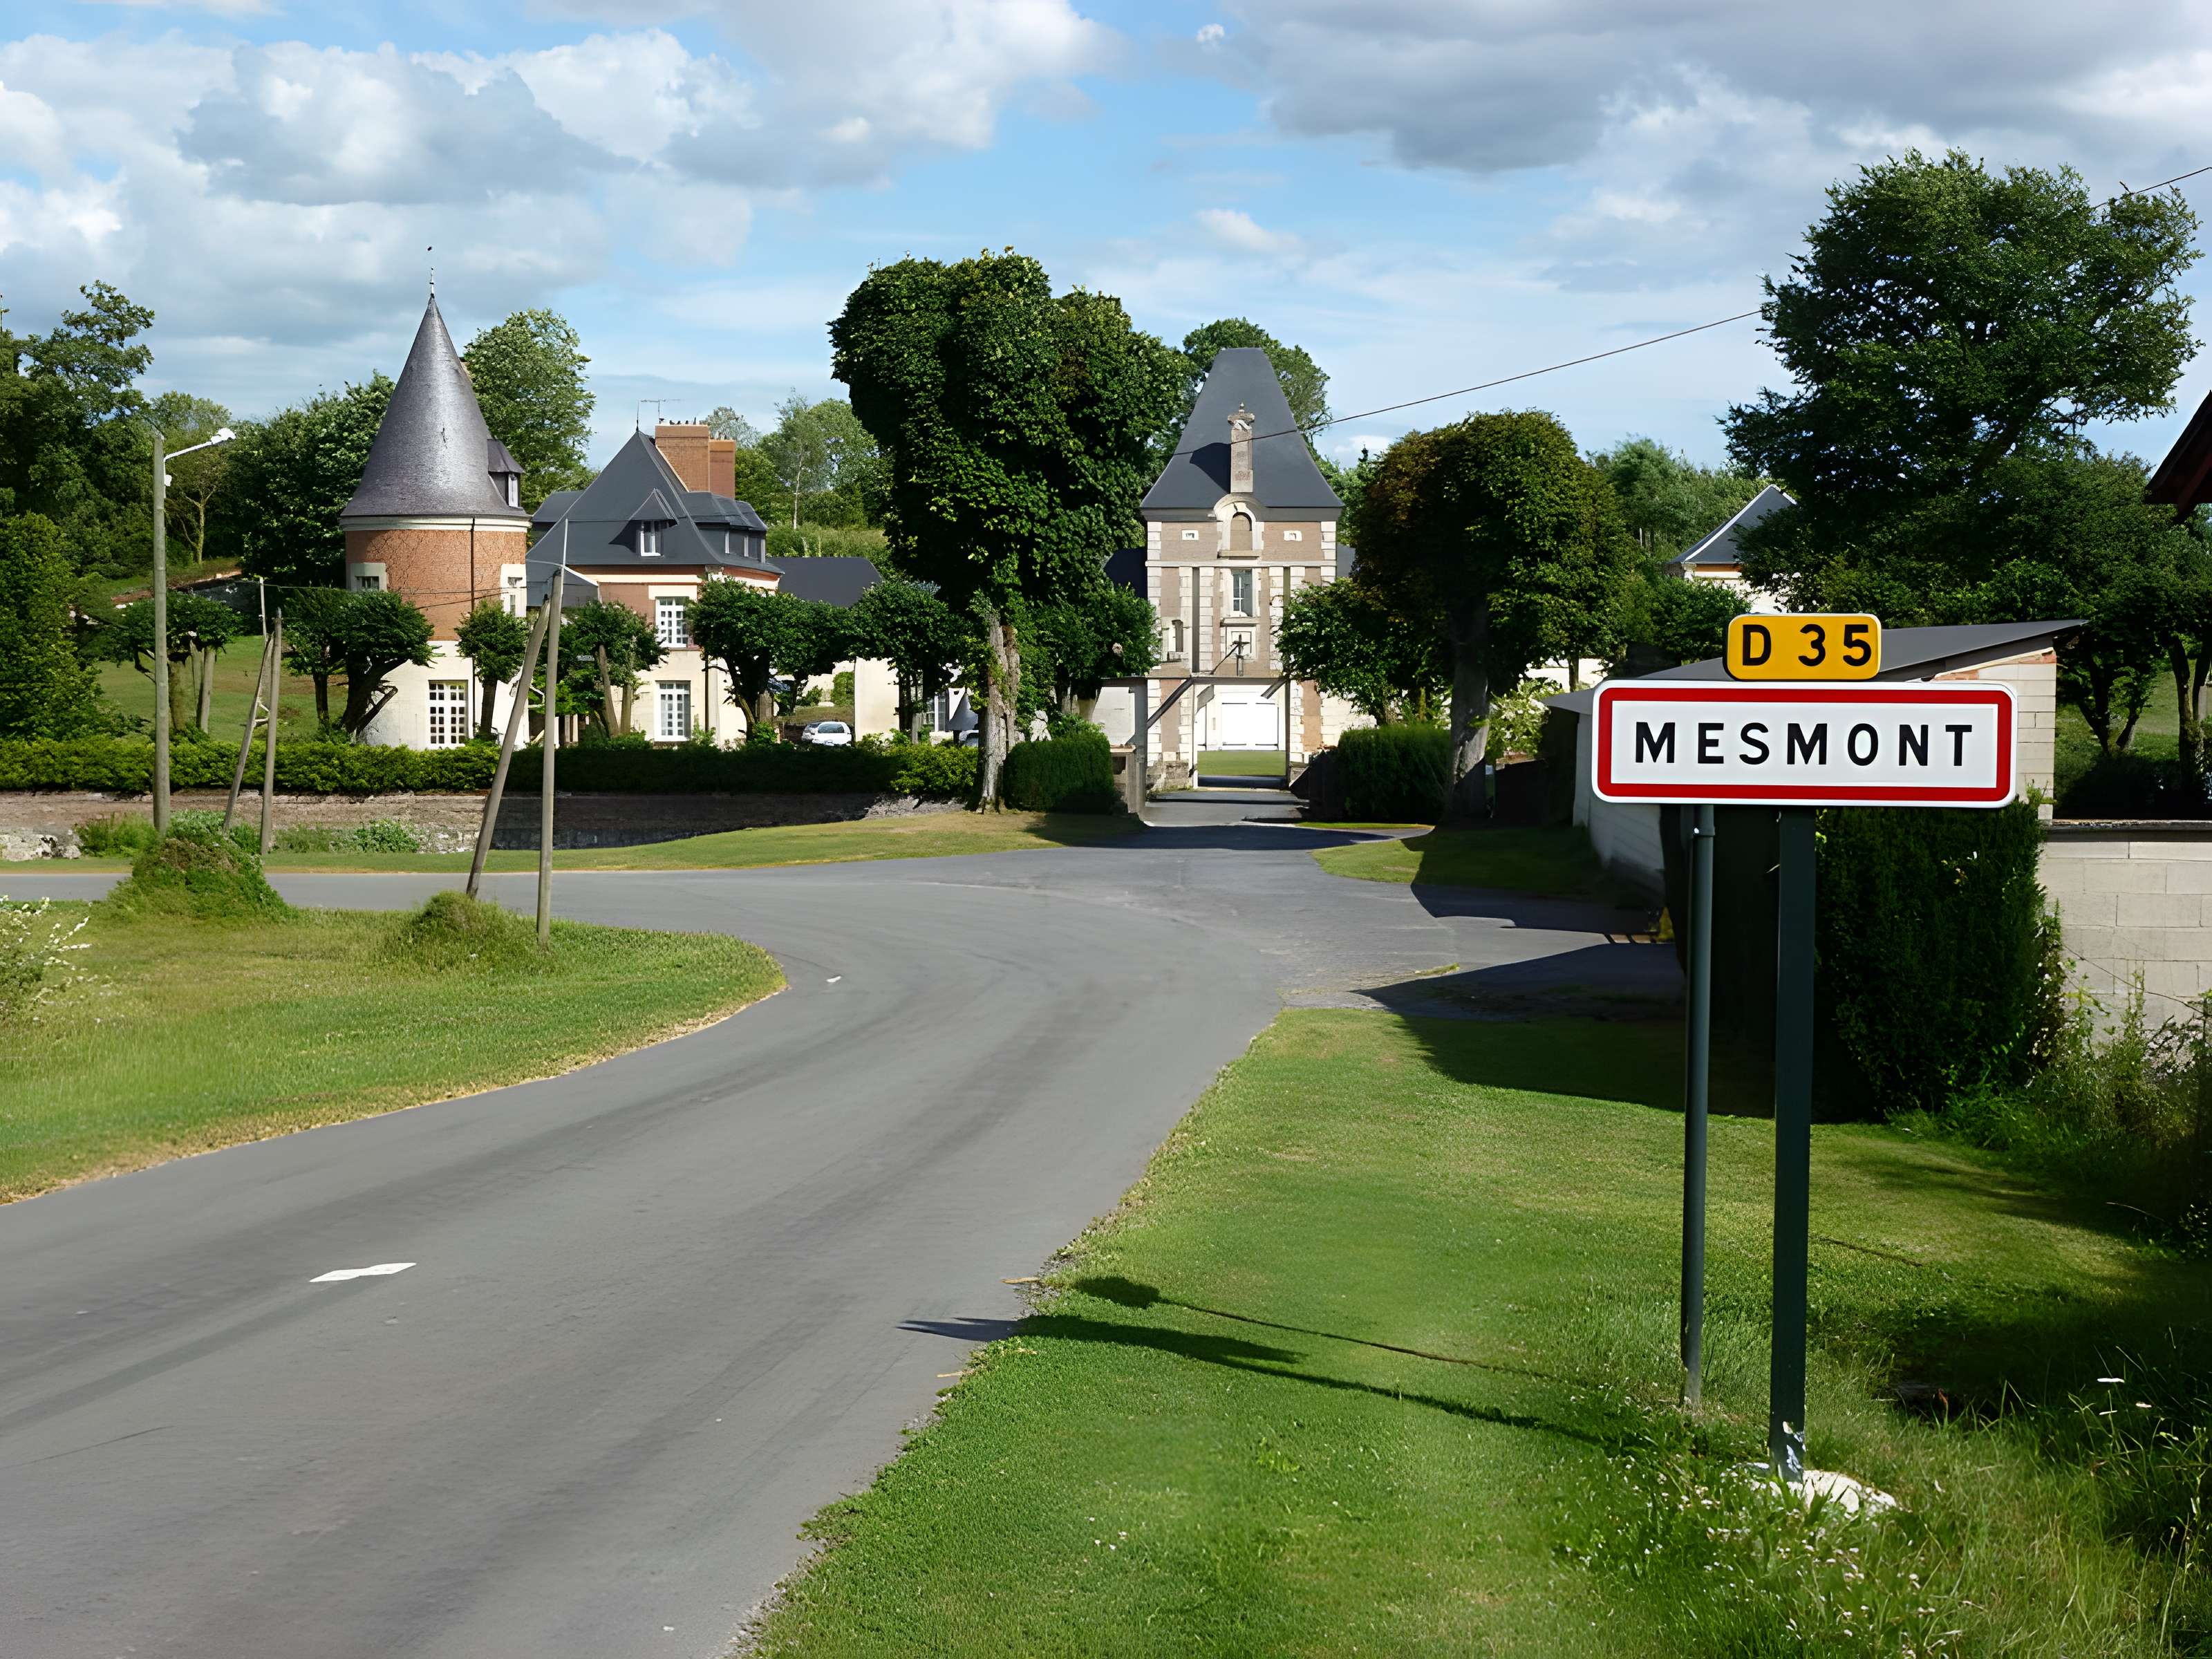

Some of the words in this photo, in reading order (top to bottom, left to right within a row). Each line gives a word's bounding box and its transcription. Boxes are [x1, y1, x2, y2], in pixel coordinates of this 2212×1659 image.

[1741, 624, 1772, 666] D
[1798, 624, 1872, 667] 35
[1635, 722, 1973, 767] MESMONT
